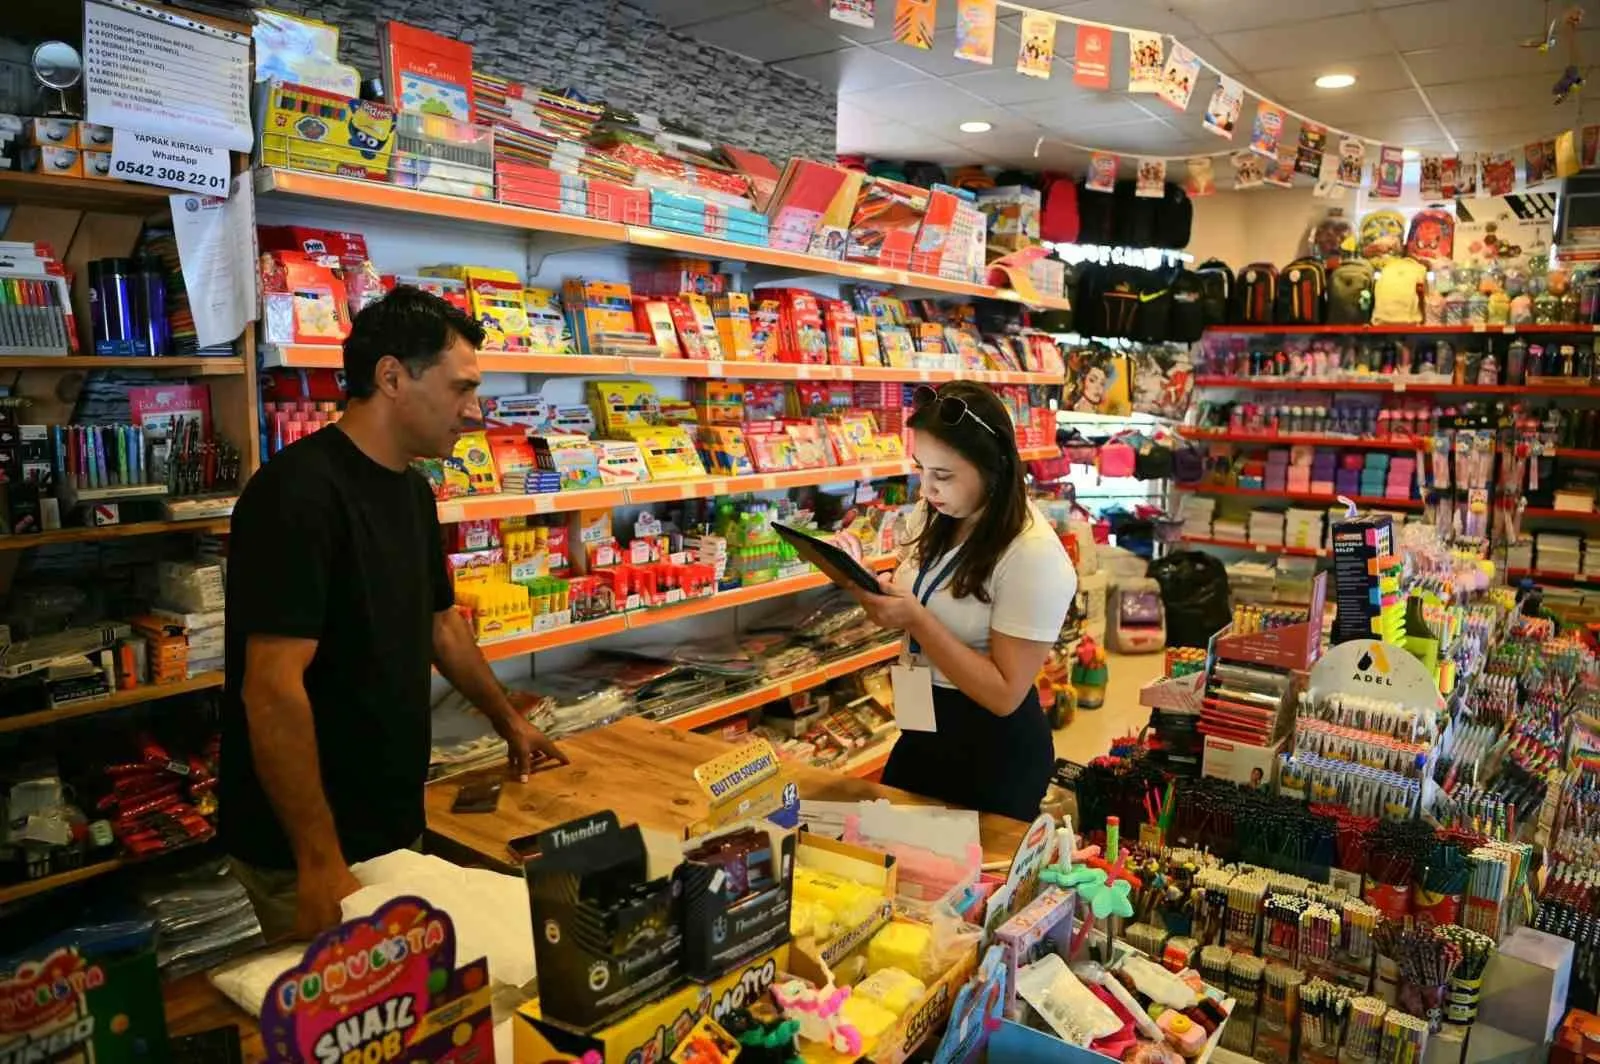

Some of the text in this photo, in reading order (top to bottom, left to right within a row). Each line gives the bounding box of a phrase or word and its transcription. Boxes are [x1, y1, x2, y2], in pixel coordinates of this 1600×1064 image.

[134, 134, 169, 146] YAPRAK
[152, 150, 198, 165] WhatsApp
[116, 160, 225, 189] 0542 308 22 01
[1352, 672, 1393, 686] ADEL
[710, 752, 772, 796] BUTTER SQUISHY
[552, 819, 608, 848] Thunder
[713, 958, 776, 1021] MOTTO
[314, 996, 416, 1064] SNAIL
